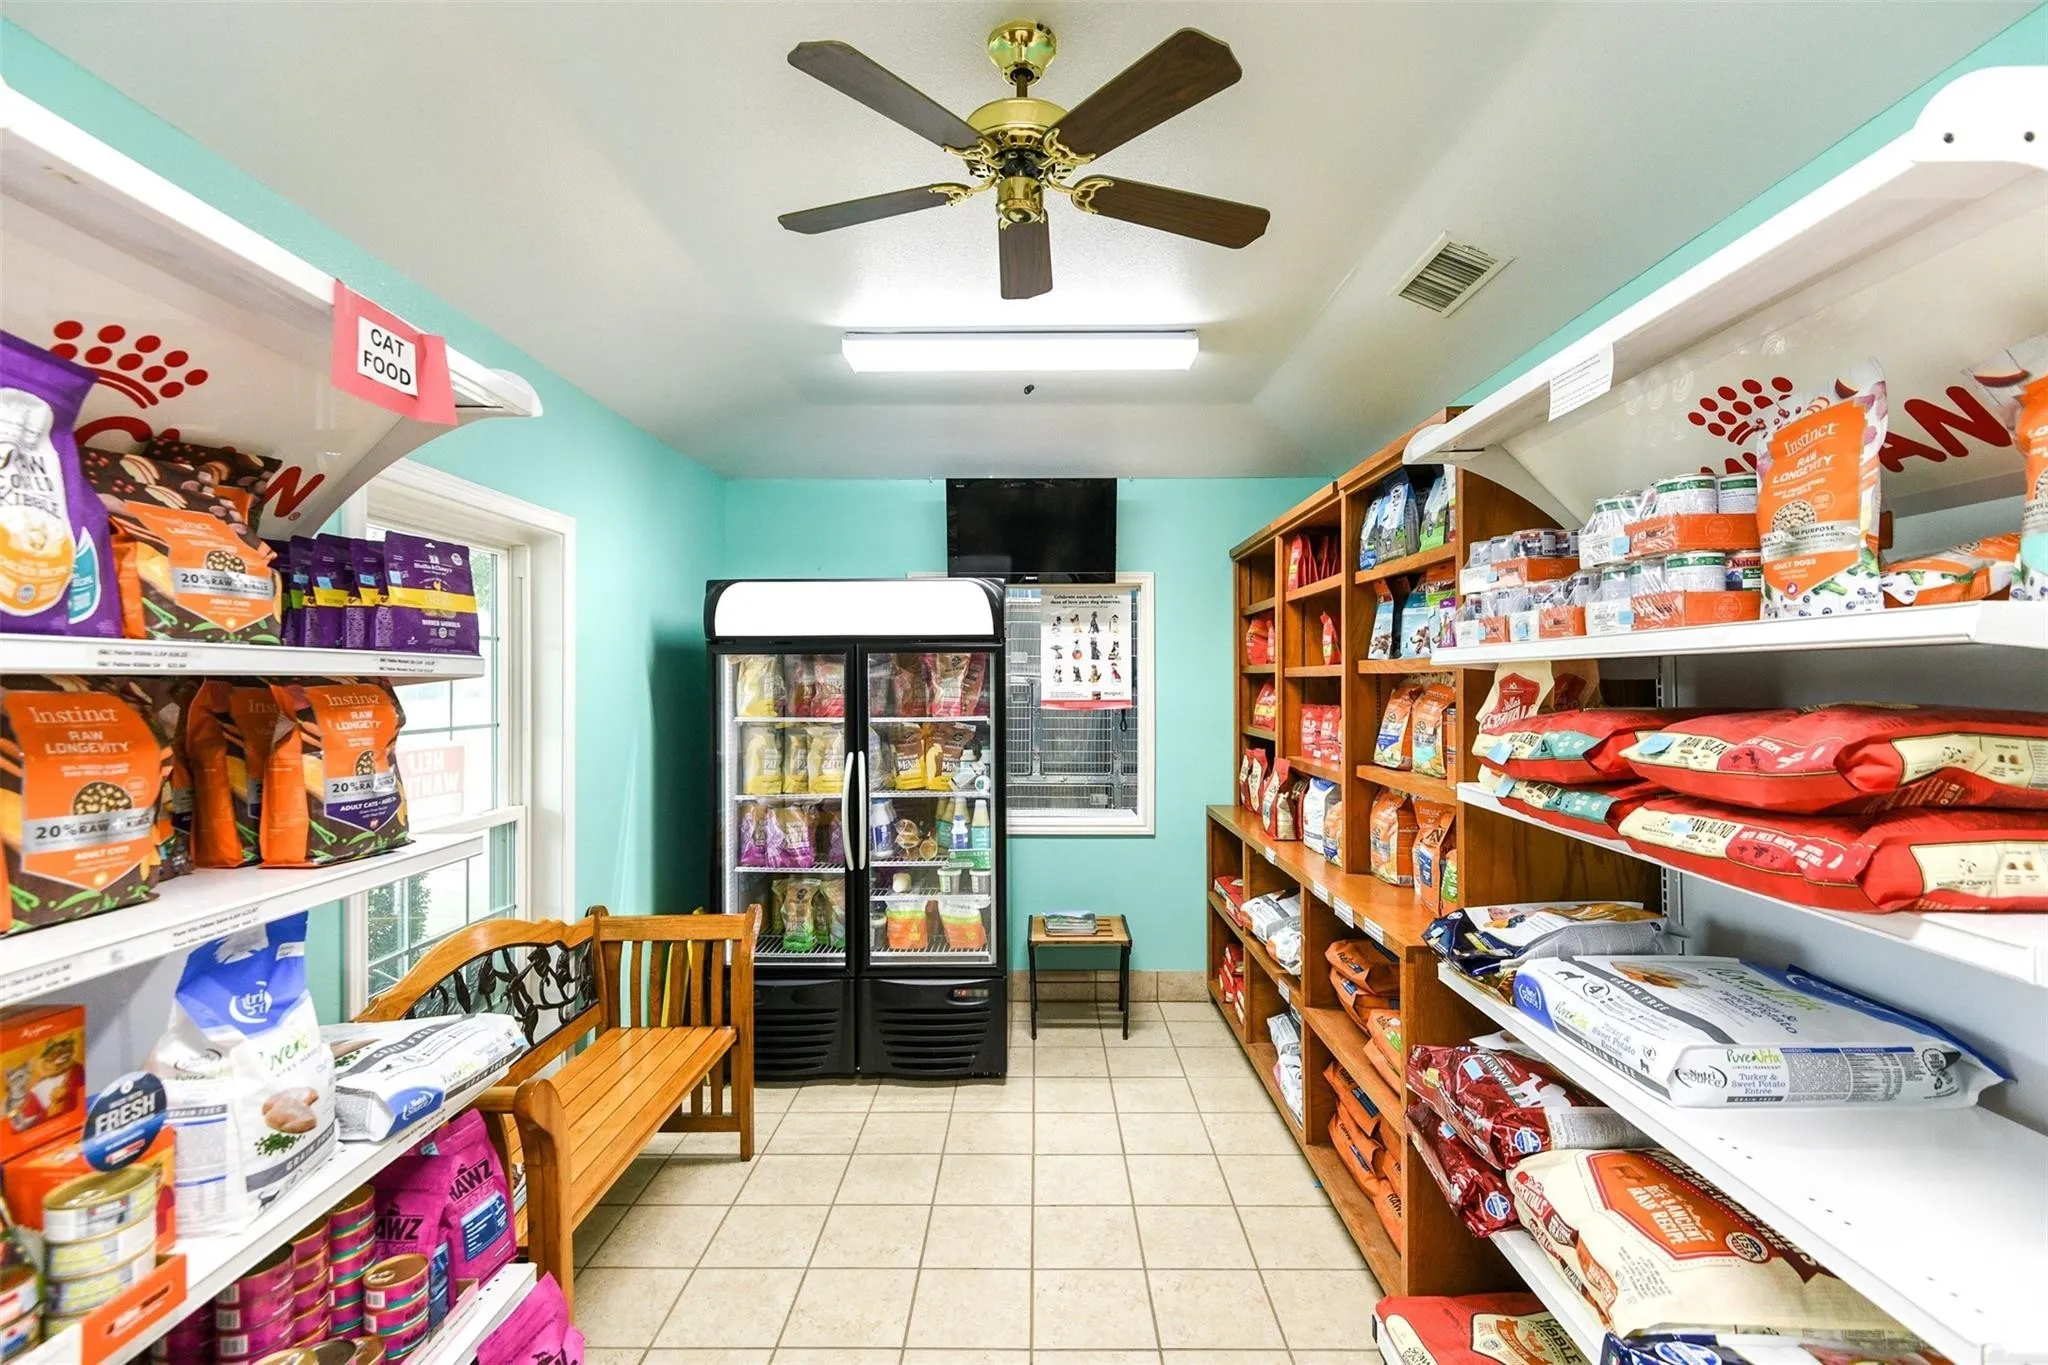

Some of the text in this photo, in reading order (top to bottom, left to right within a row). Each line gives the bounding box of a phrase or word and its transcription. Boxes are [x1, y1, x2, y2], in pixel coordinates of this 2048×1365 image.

[370, 328, 404, 358] CAT
[363, 351, 411, 387] FOOD
[1784, 422, 1839, 457] Instinct
[1797, 450, 1817, 469] RAW
[1772, 454, 1836, 485] LONGEVITY
[1732, 558, 1761, 568] Natur
[1794, 558, 1816, 567] DOGS
[180, 573, 210, 586] 20%
[28, 706, 118, 724] Instinct
[351, 710, 373, 720] RAW
[68, 730, 104, 741] RAW
[44, 742, 129, 755] LONGEVITY
[332, 781, 374, 793] 20% RA
[340, 801, 378, 812] ADULT CATS
[35, 824, 77, 840] 20%
[79, 823, 110, 834] RAW
[1705, 821, 1737, 839] BLEND
[1589, 984, 1604, 994] 4
[1610, 977, 1669, 1012] GRAIN FREE
[407, 1027, 438, 1047] FREE
[1731, 1080, 1786, 1088] Sweet Potato
[1739, 1073, 1769, 1081] Turkey
[94, 1093, 156, 1137] FRESH
[374, 1217, 424, 1240] AWZ
[1735, 1233, 1758, 1260] USA
